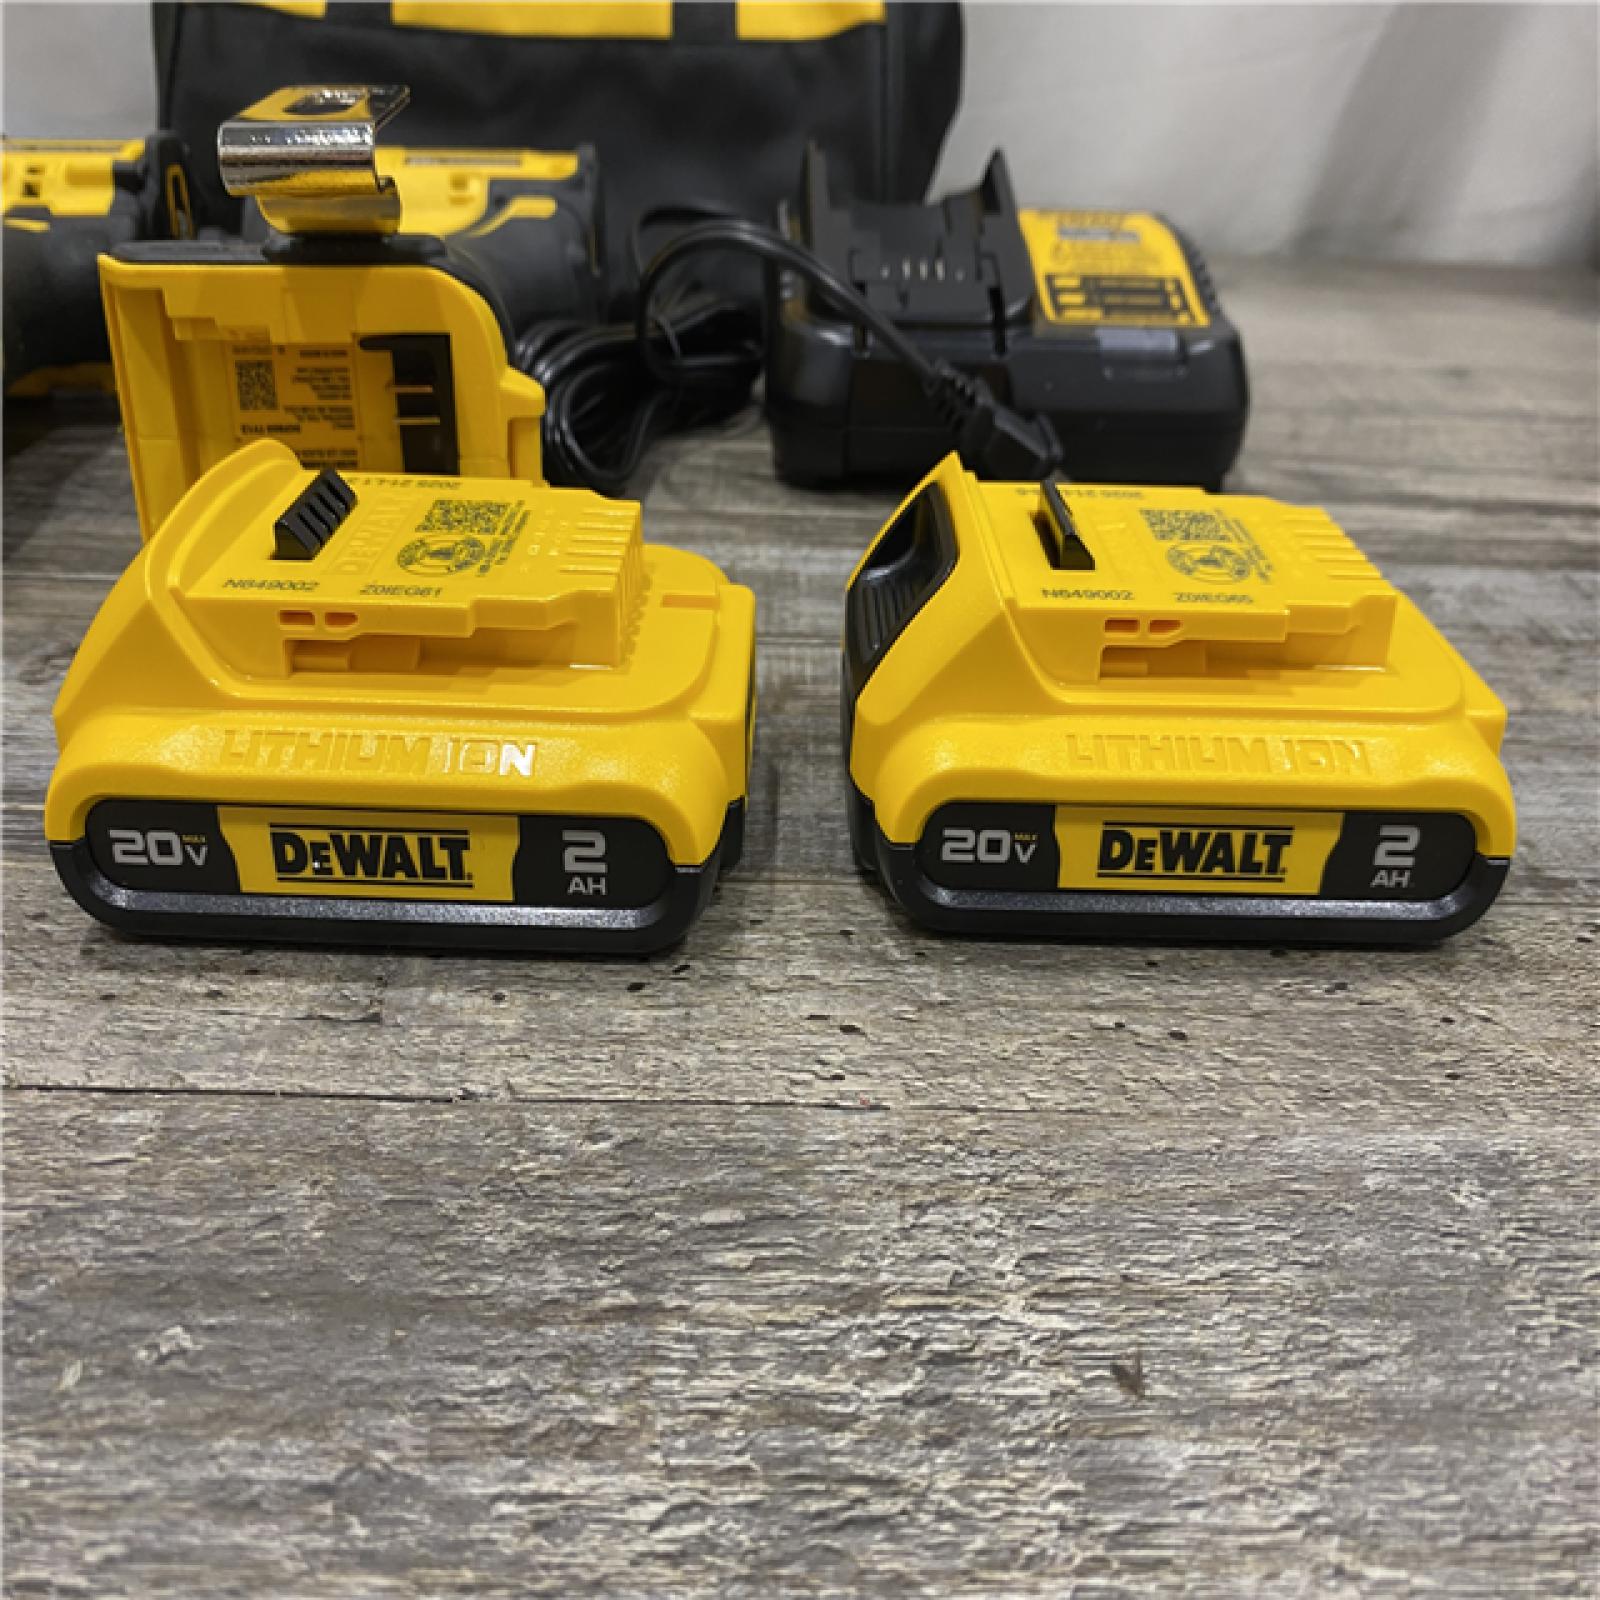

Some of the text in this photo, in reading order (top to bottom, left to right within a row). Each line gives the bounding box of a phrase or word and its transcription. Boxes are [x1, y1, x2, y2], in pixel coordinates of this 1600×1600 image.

[220, 728, 537, 778] LITHIUM ION
[1065, 733, 1371, 776] LITHIUM ION
[561, 830, 608, 874] 2
[1375, 825, 1421, 867] 2
[567, 877, 607, 896] AH
[1370, 869, 1412, 889] AH
